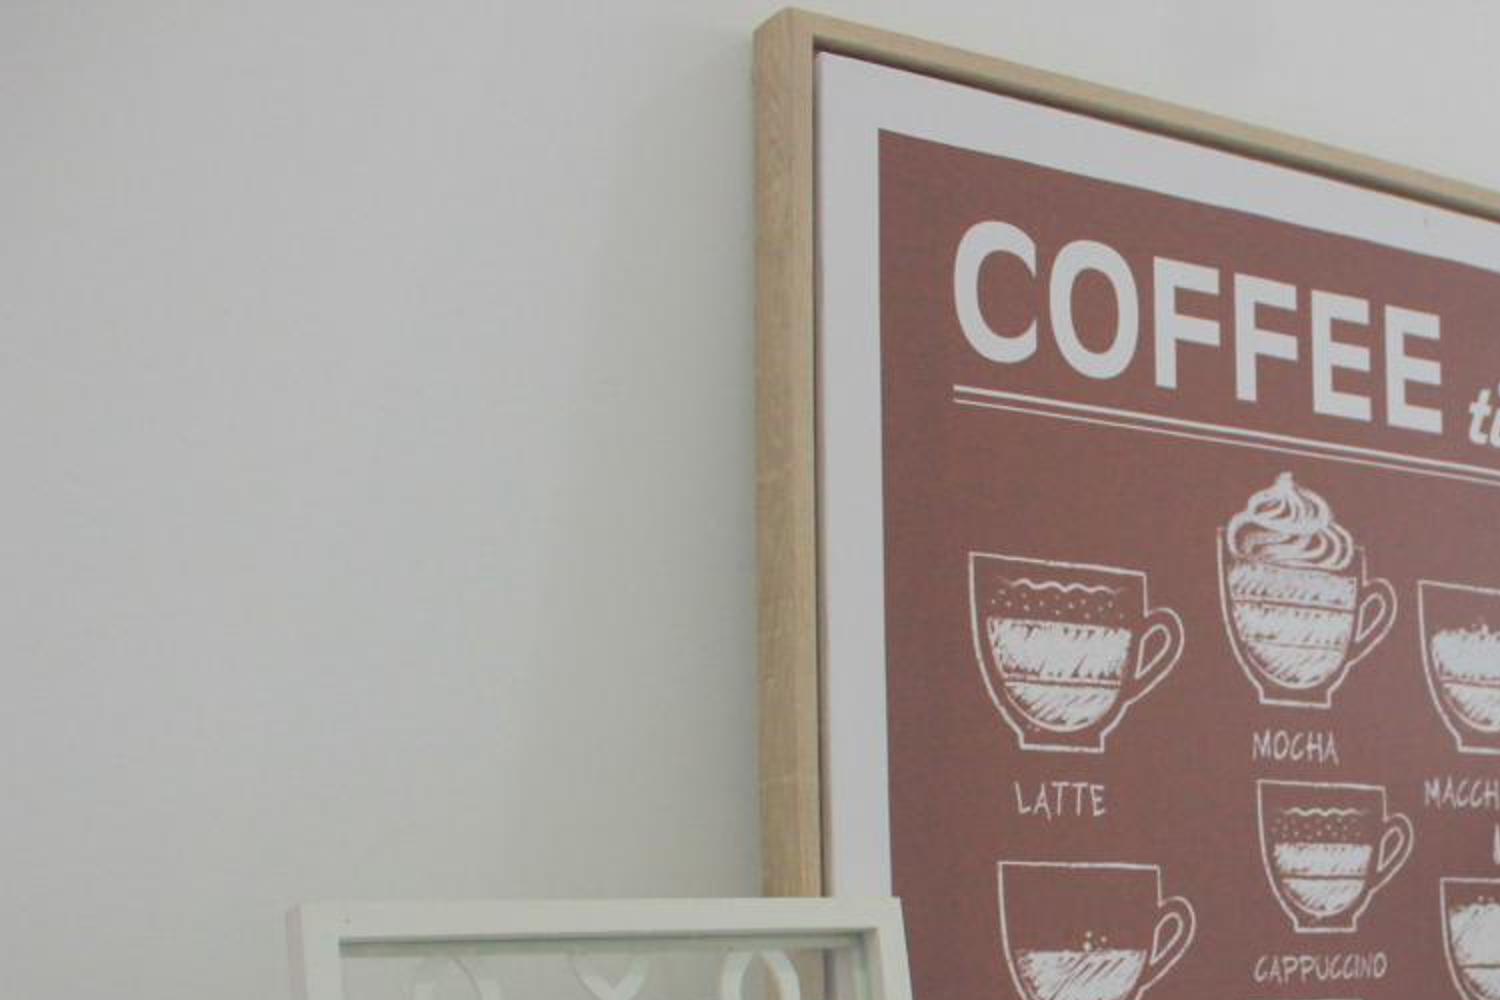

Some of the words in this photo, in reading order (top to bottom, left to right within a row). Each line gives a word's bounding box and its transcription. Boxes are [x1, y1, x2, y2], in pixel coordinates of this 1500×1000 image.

[954, 221, 1443, 434] COFFEE
[1253, 730, 1338, 764] MOCHA
[1015, 781, 1105, 819] LATTE
[1254, 952, 1387, 983] CAPPUCCINO
